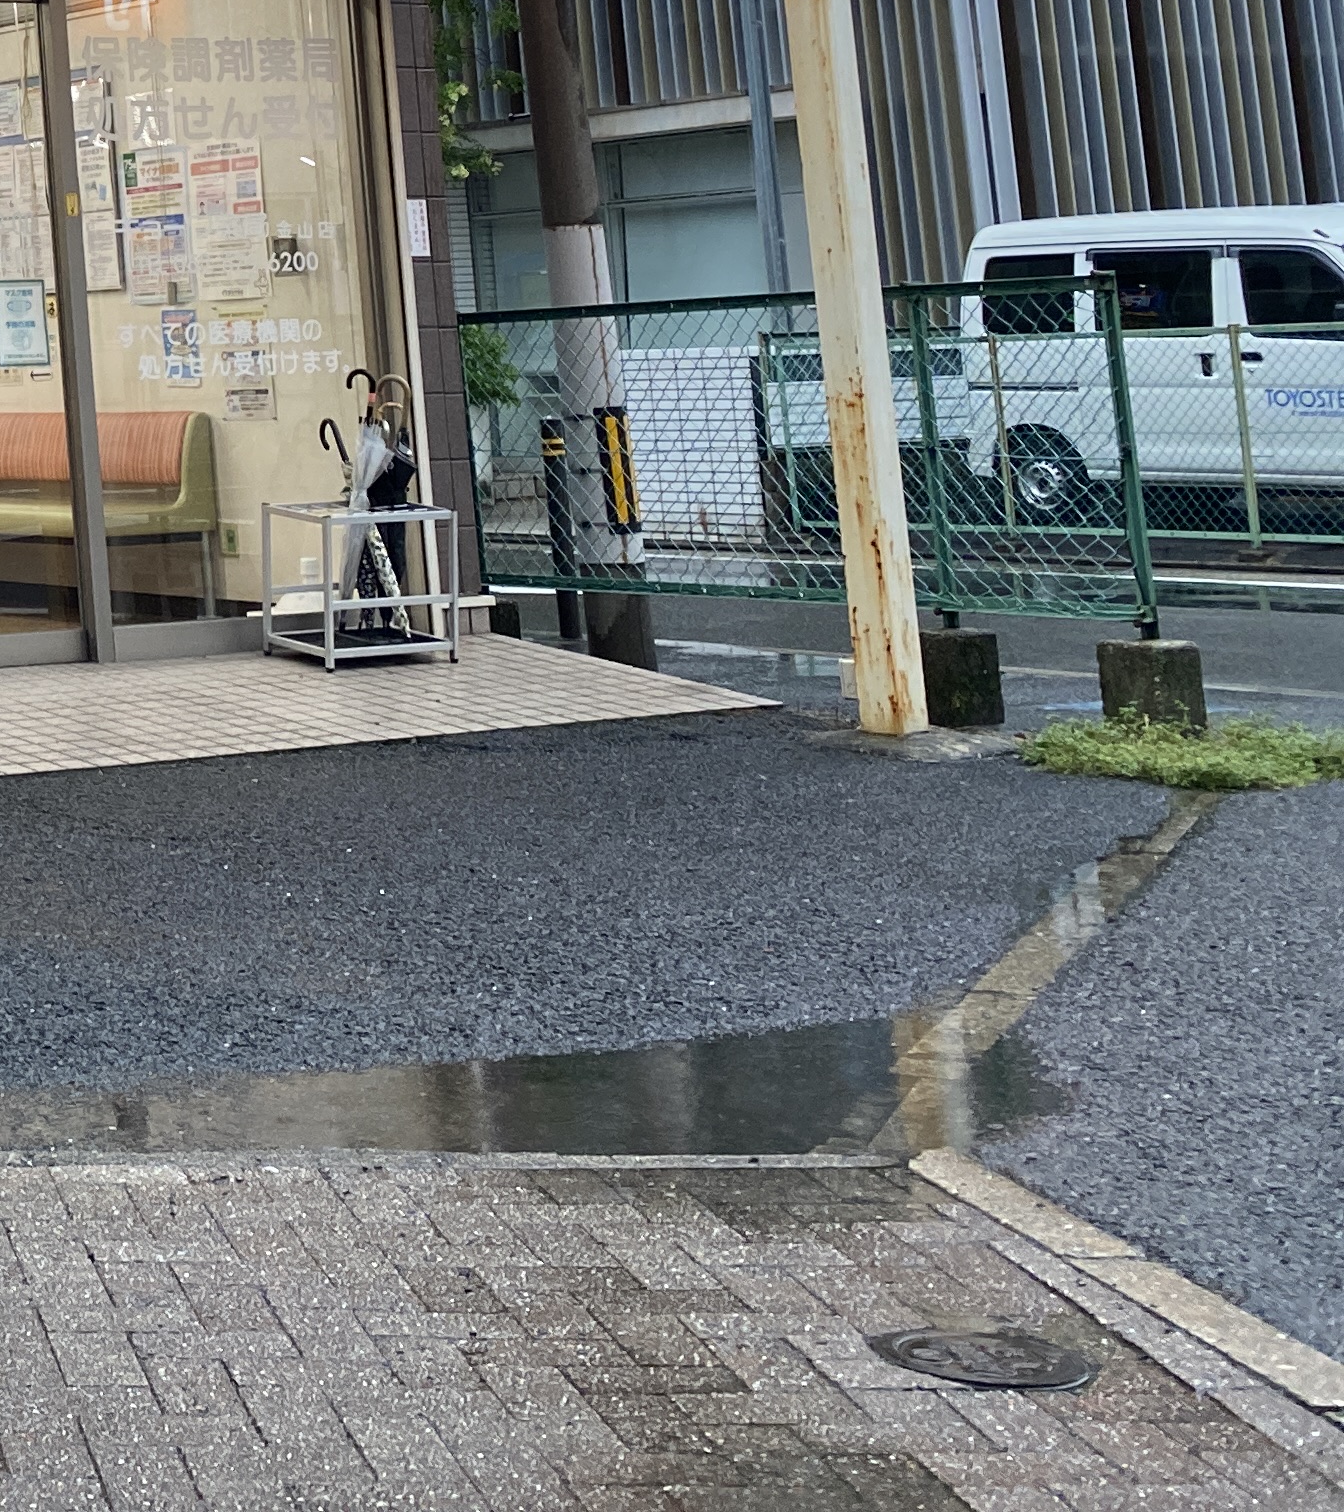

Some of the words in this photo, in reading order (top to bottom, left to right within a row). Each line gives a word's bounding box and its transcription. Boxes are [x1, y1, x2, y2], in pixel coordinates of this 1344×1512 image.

[81, 35, 339, 83] 保険調剤薬局
[84, 94, 339, 142] 処方せん受付
[116, 318, 322, 348] すべての医療機関の
[138, 349, 351, 381] 処方せん受付けます。
